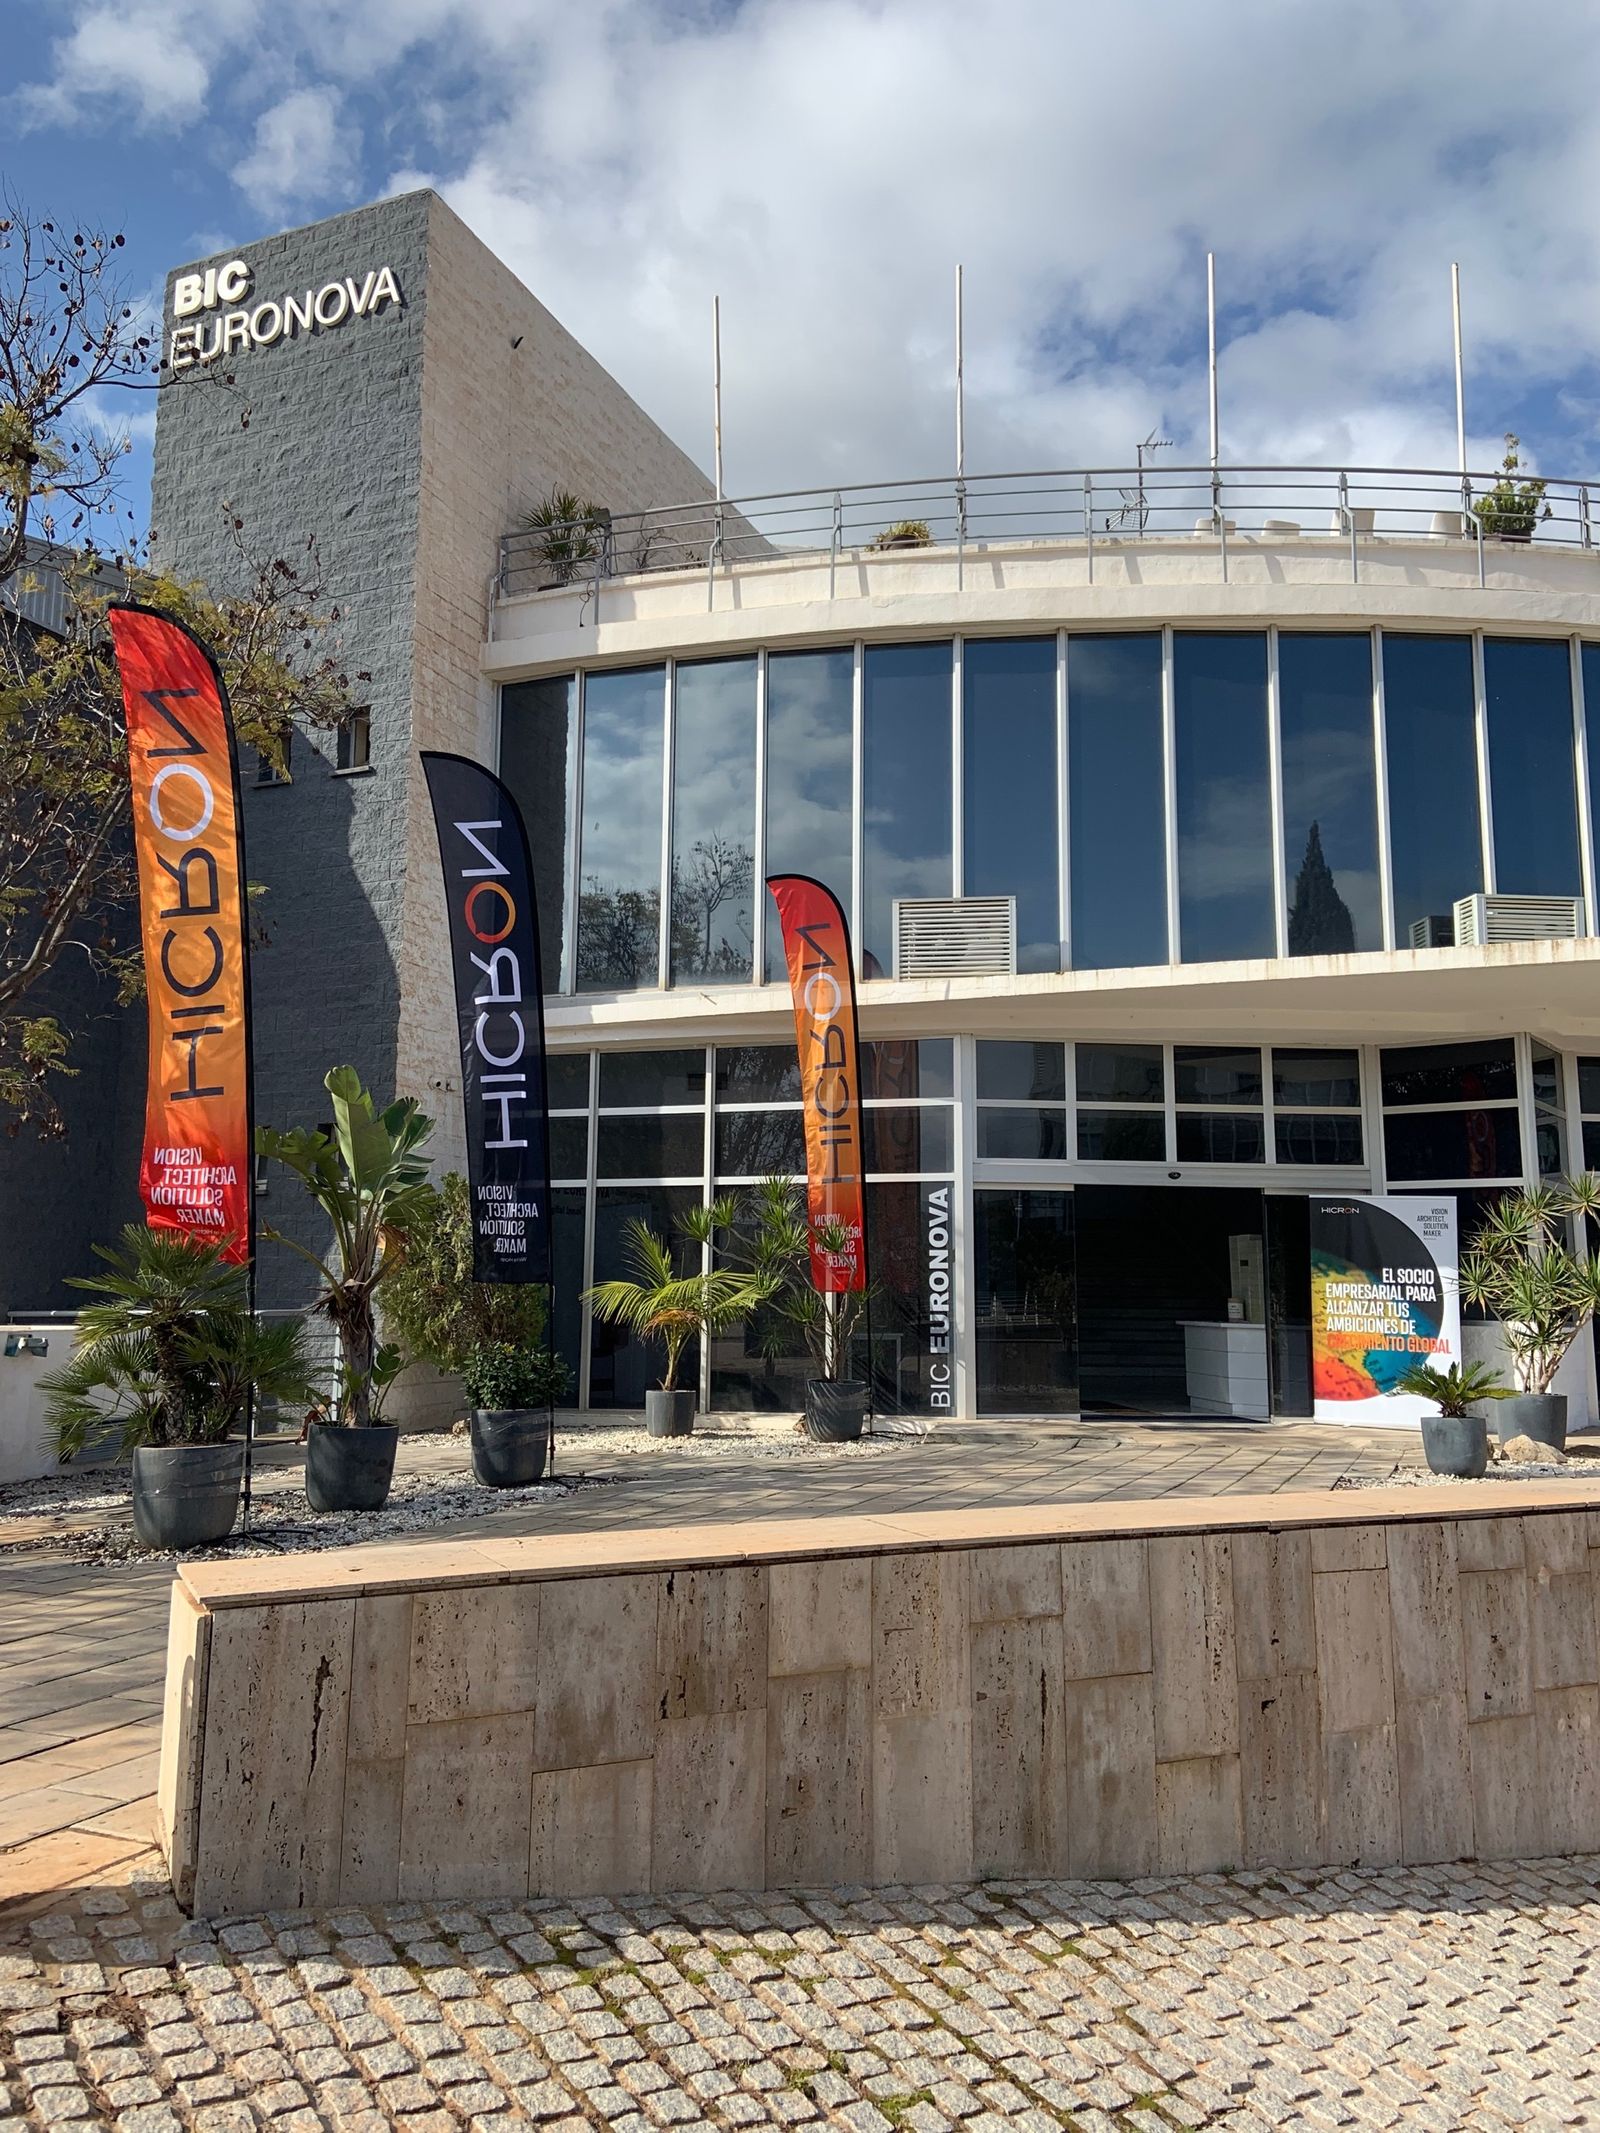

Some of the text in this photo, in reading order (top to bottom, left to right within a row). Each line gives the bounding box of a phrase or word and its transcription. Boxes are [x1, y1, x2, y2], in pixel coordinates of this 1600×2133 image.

[174, 260, 249, 317] BIC
[170, 266, 401, 369] EURONOVA
[1321, 1206, 1360, 1214] HICRON
[1423, 1222, 1448, 1230] SOLUTION
[1382, 1268, 1435, 1285] EL SOCIO
[929, 1187, 950, 1408] BIC EURONOVA
[1325, 1283, 1437, 1302] EMPRESARIAL PARA
[1326, 1300, 1410, 1318] ALCANZAR TUS
[1326, 1316, 1417, 1335] AMBICIONES DE
[1407, 1336, 1452, 1354] GLOBAL
